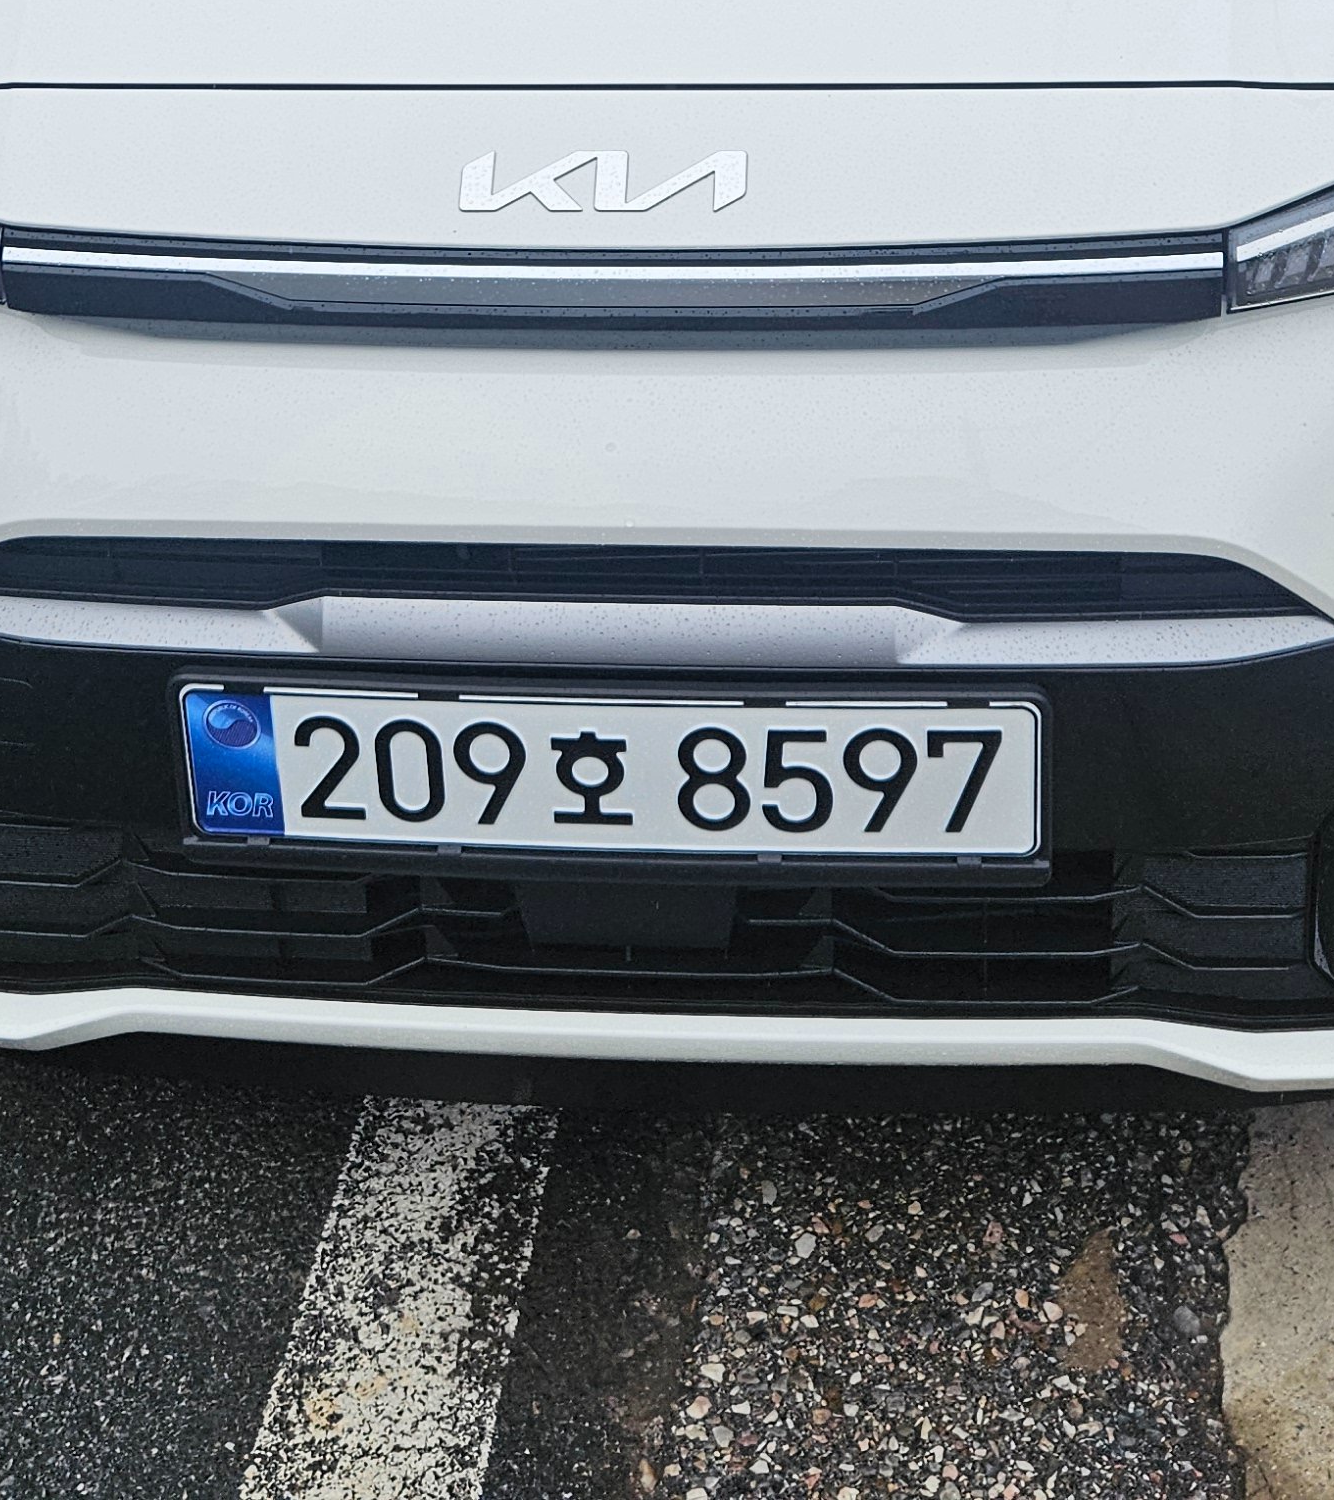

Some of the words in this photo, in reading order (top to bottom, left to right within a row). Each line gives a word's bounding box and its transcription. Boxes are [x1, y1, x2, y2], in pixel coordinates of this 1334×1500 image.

[458, 149, 749, 213] KIA
[206, 790, 274, 818] KOR
[293, 714, 634, 826] 209호
[676, 724, 1003, 834] 8597
